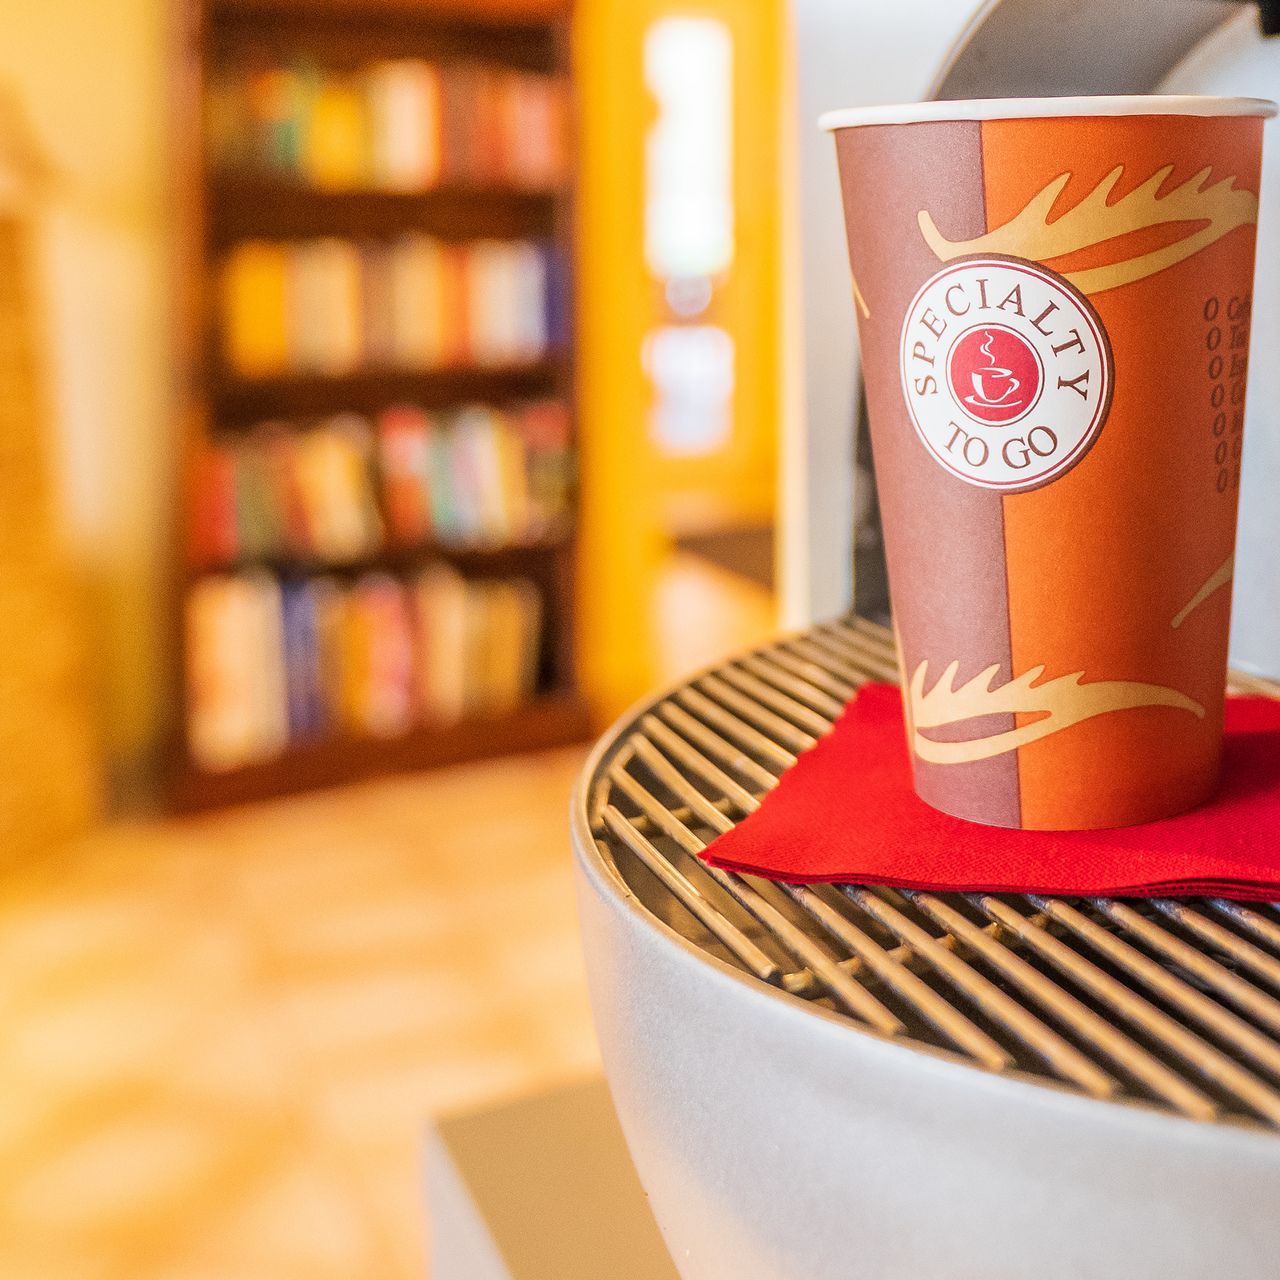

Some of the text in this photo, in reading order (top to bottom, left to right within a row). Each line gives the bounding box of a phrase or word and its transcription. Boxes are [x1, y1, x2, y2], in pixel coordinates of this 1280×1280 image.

[912, 278, 1090, 401] SPECIALTY
[943, 420, 1059, 470] TO GO
